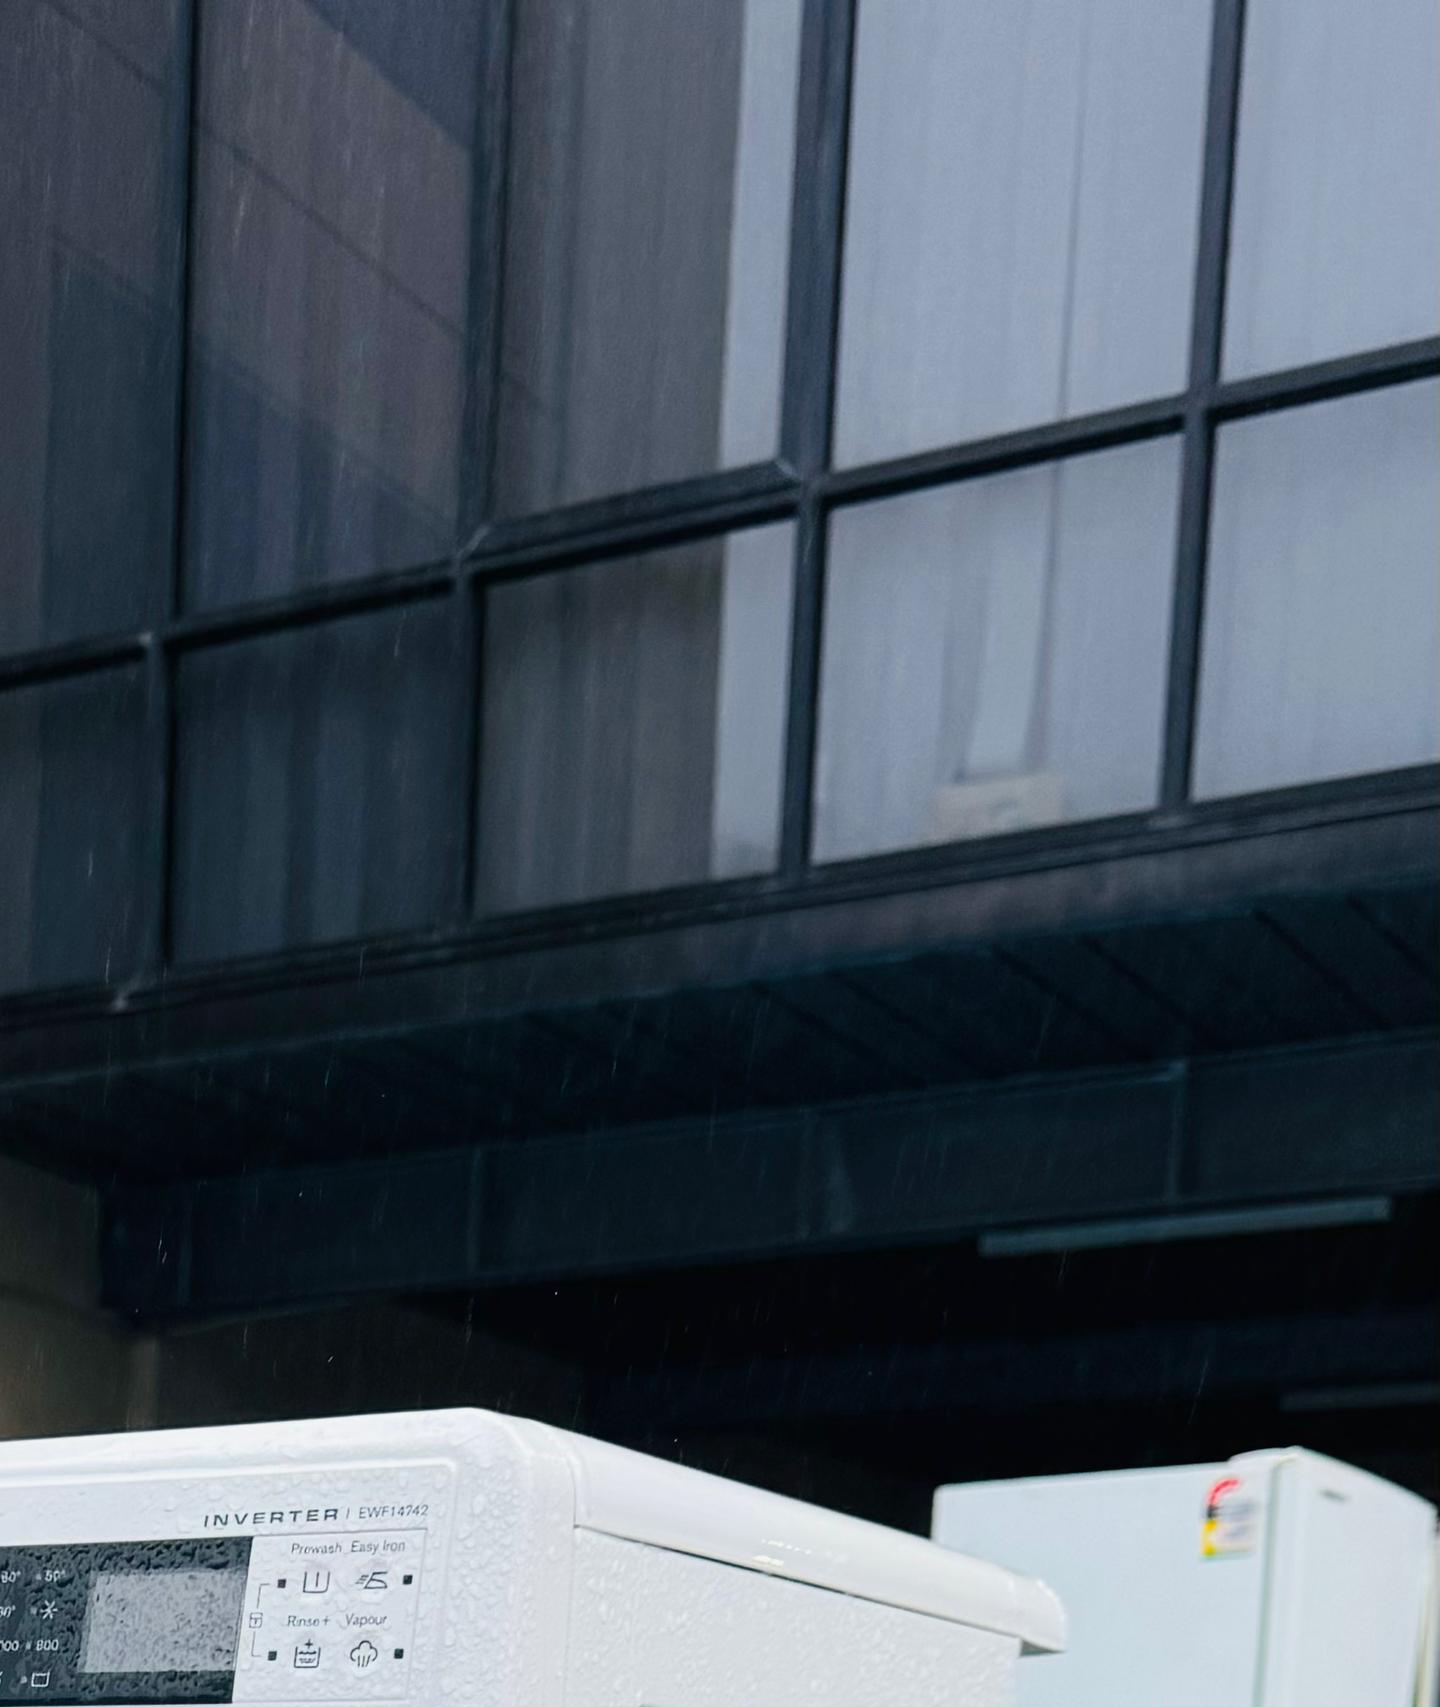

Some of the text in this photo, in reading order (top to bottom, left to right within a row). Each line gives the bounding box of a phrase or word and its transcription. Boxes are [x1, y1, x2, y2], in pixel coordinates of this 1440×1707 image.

[204, 1508, 339, 1527] INVERTER
[351, 1539, 405, 1555] Easy Iron
[345, 1613, 387, 1628] Vapour
